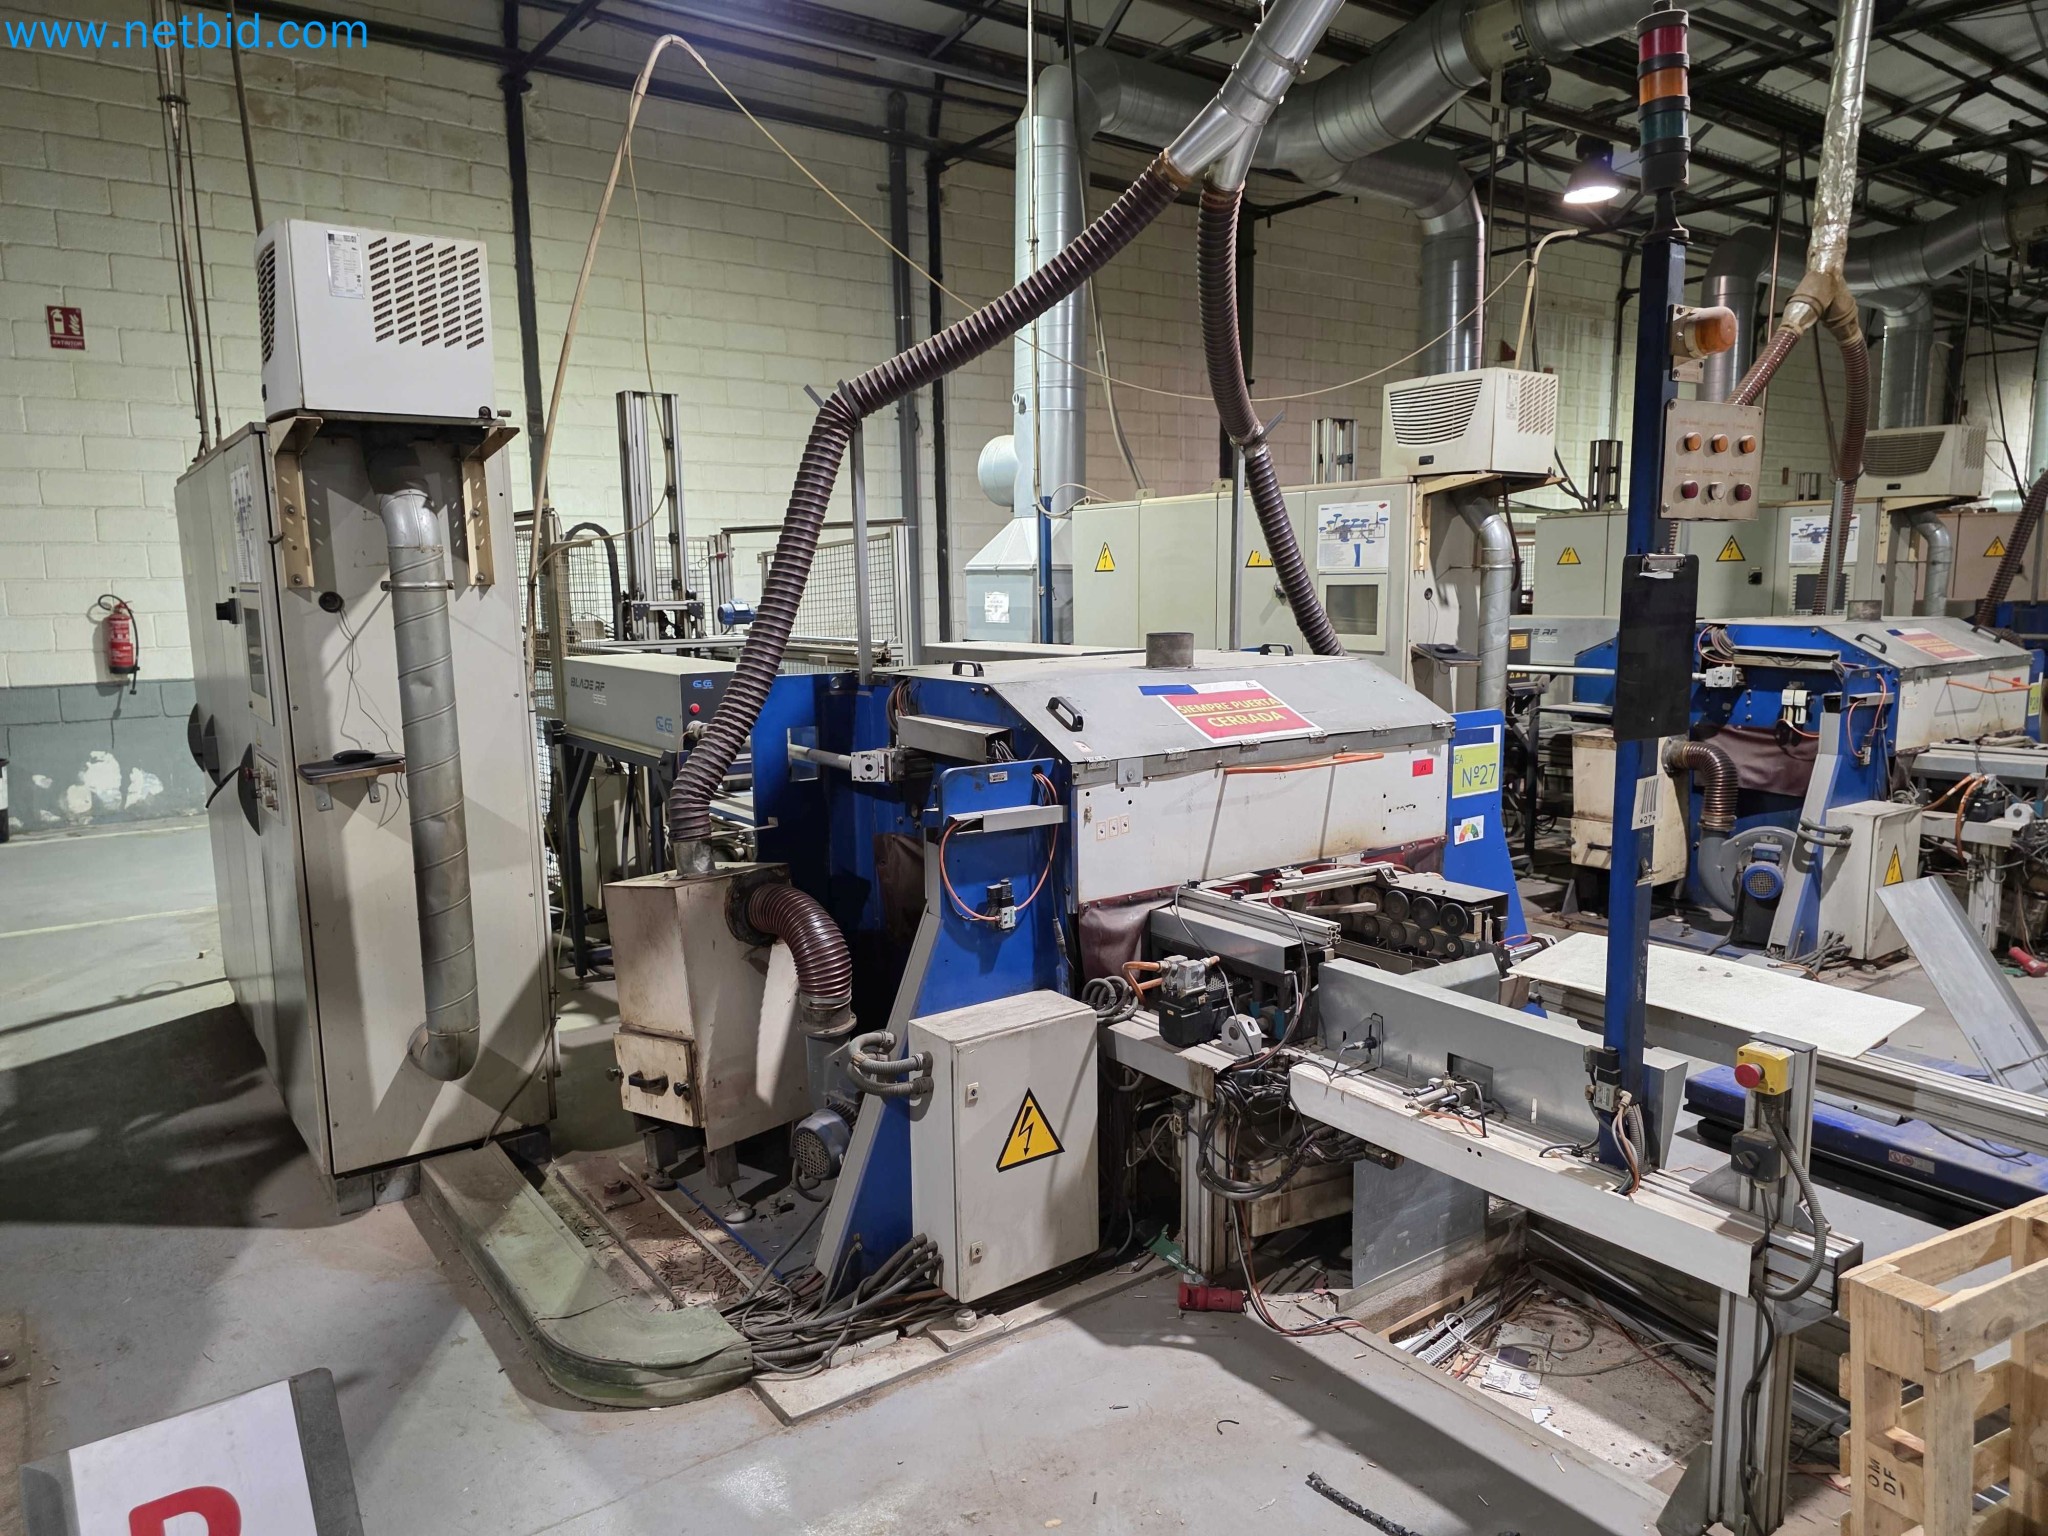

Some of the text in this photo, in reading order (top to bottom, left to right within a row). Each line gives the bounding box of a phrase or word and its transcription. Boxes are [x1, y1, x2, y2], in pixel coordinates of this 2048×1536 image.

[570, 676, 606, 692] BLADE RF
[1177, 697, 1281, 715] SIEMPRE PUERTA
[1207, 710, 1287, 728] CERRADA
